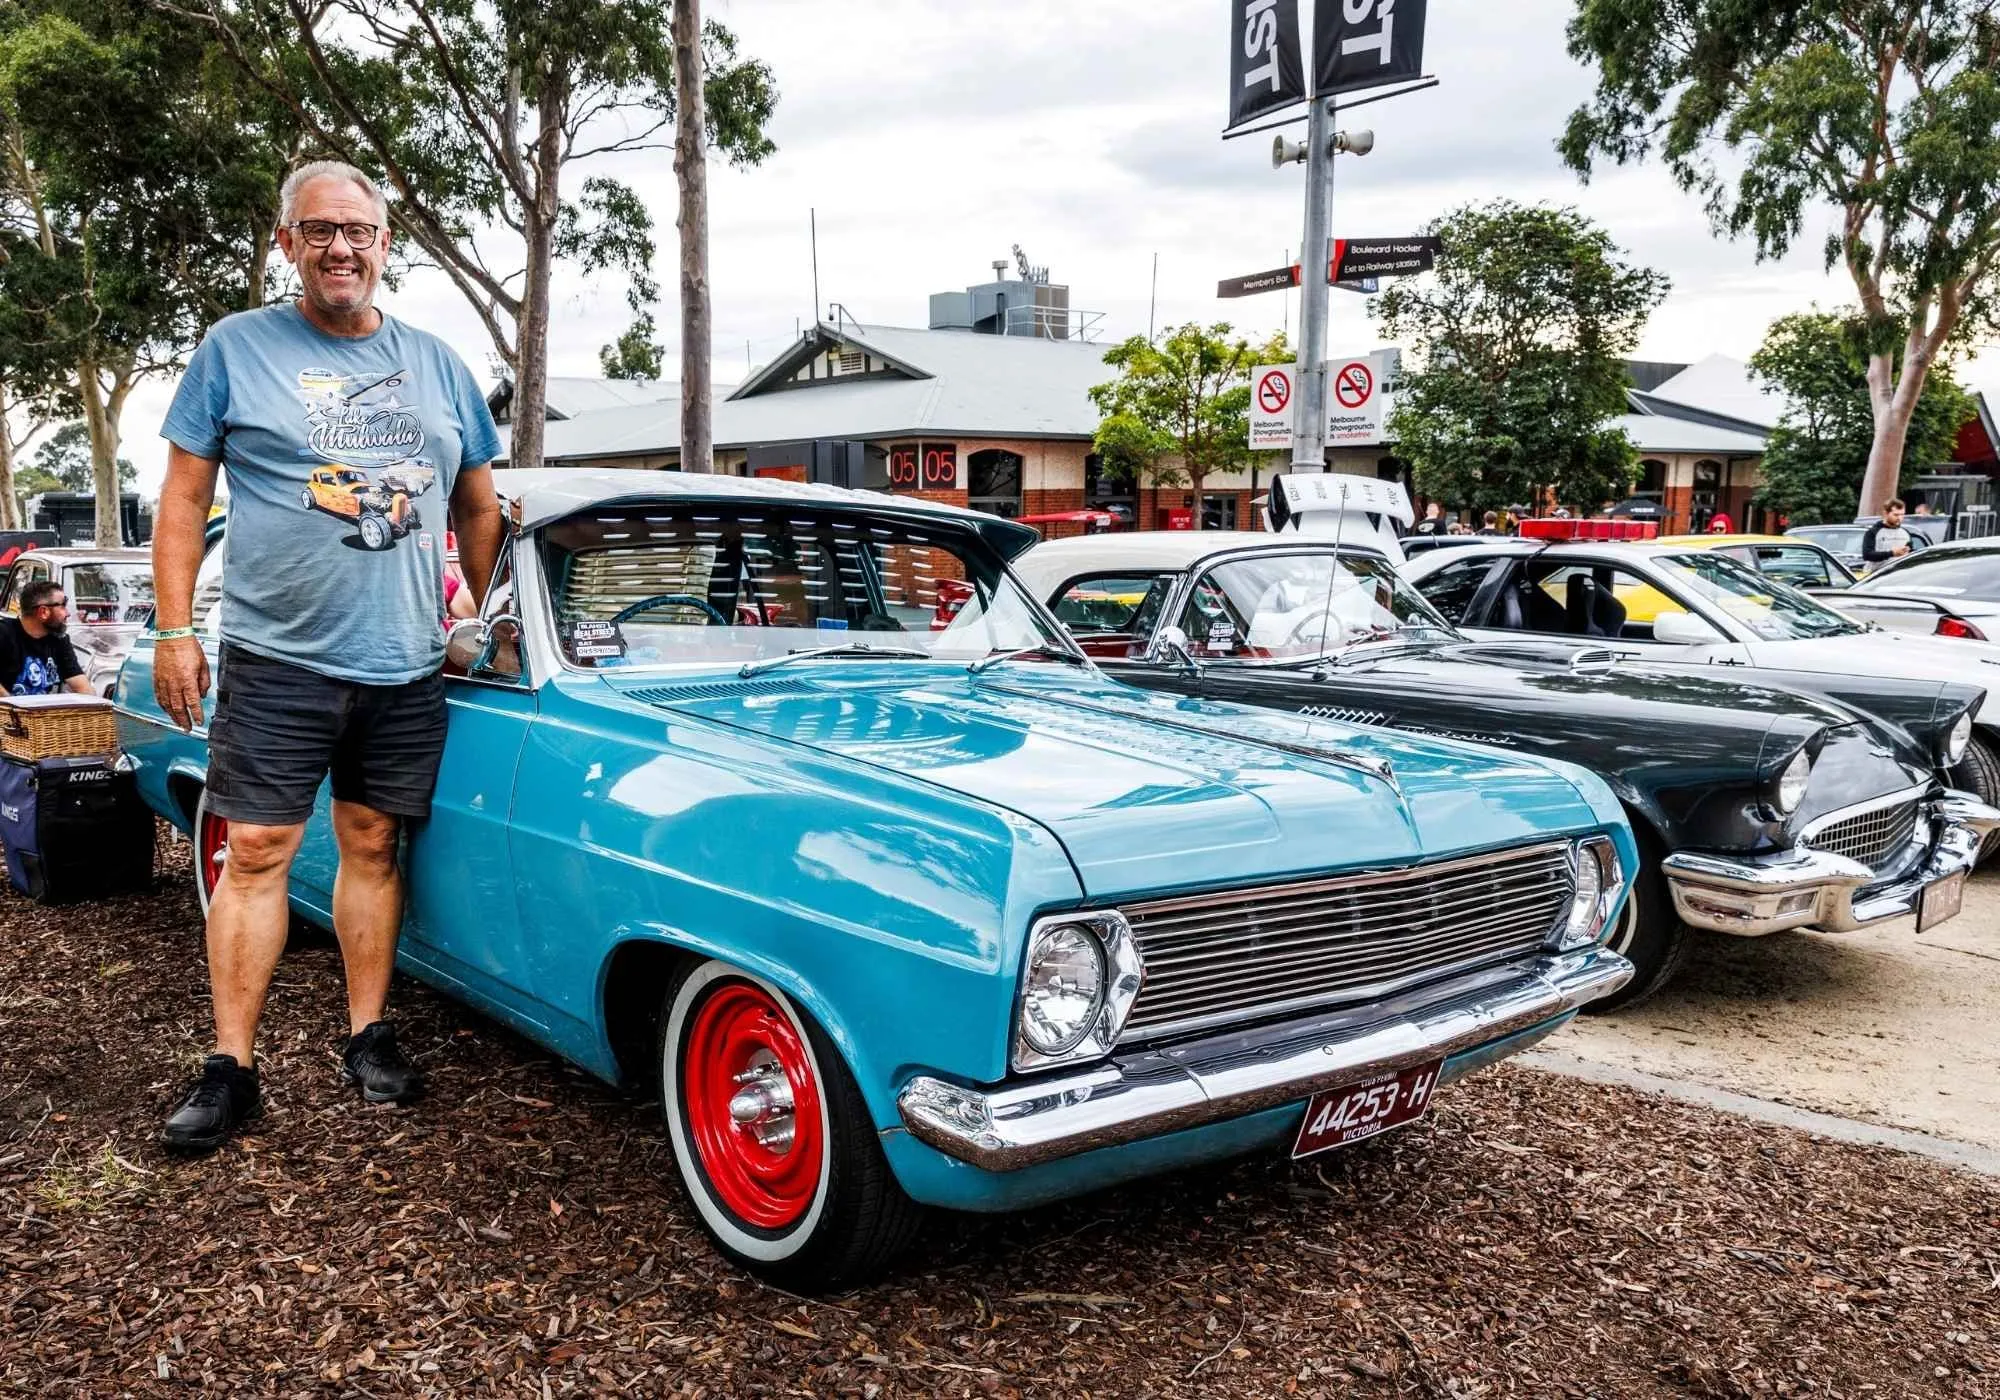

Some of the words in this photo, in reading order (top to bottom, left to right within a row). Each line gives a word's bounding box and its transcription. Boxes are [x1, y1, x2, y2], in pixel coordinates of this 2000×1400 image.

[1351, 244, 1391, 255] Boulevard
[1344, 264, 1357, 274] Exit
[1358, 264, 1366, 272] to
[1366, 261, 1395, 271] Railway
[1395, 259, 1421, 269] station
[1243, 277, 1275, 289] Members
[1275, 275, 1289, 284] Bar
[337, 407, 369, 425] Lake
[1330, 416, 1367, 424] Melbourne
[1253, 420, 1284, 428] Melbourne
[1330, 423, 1375, 432] Showgrounds
[317, 418, 418, 450] Mulwala
[1253, 427, 1292, 437] Showgrounds
[892, 451, 916, 482] 05
[926, 450, 955, 482] 05
[1342, 1120, 1382, 1141] VICTORIA
